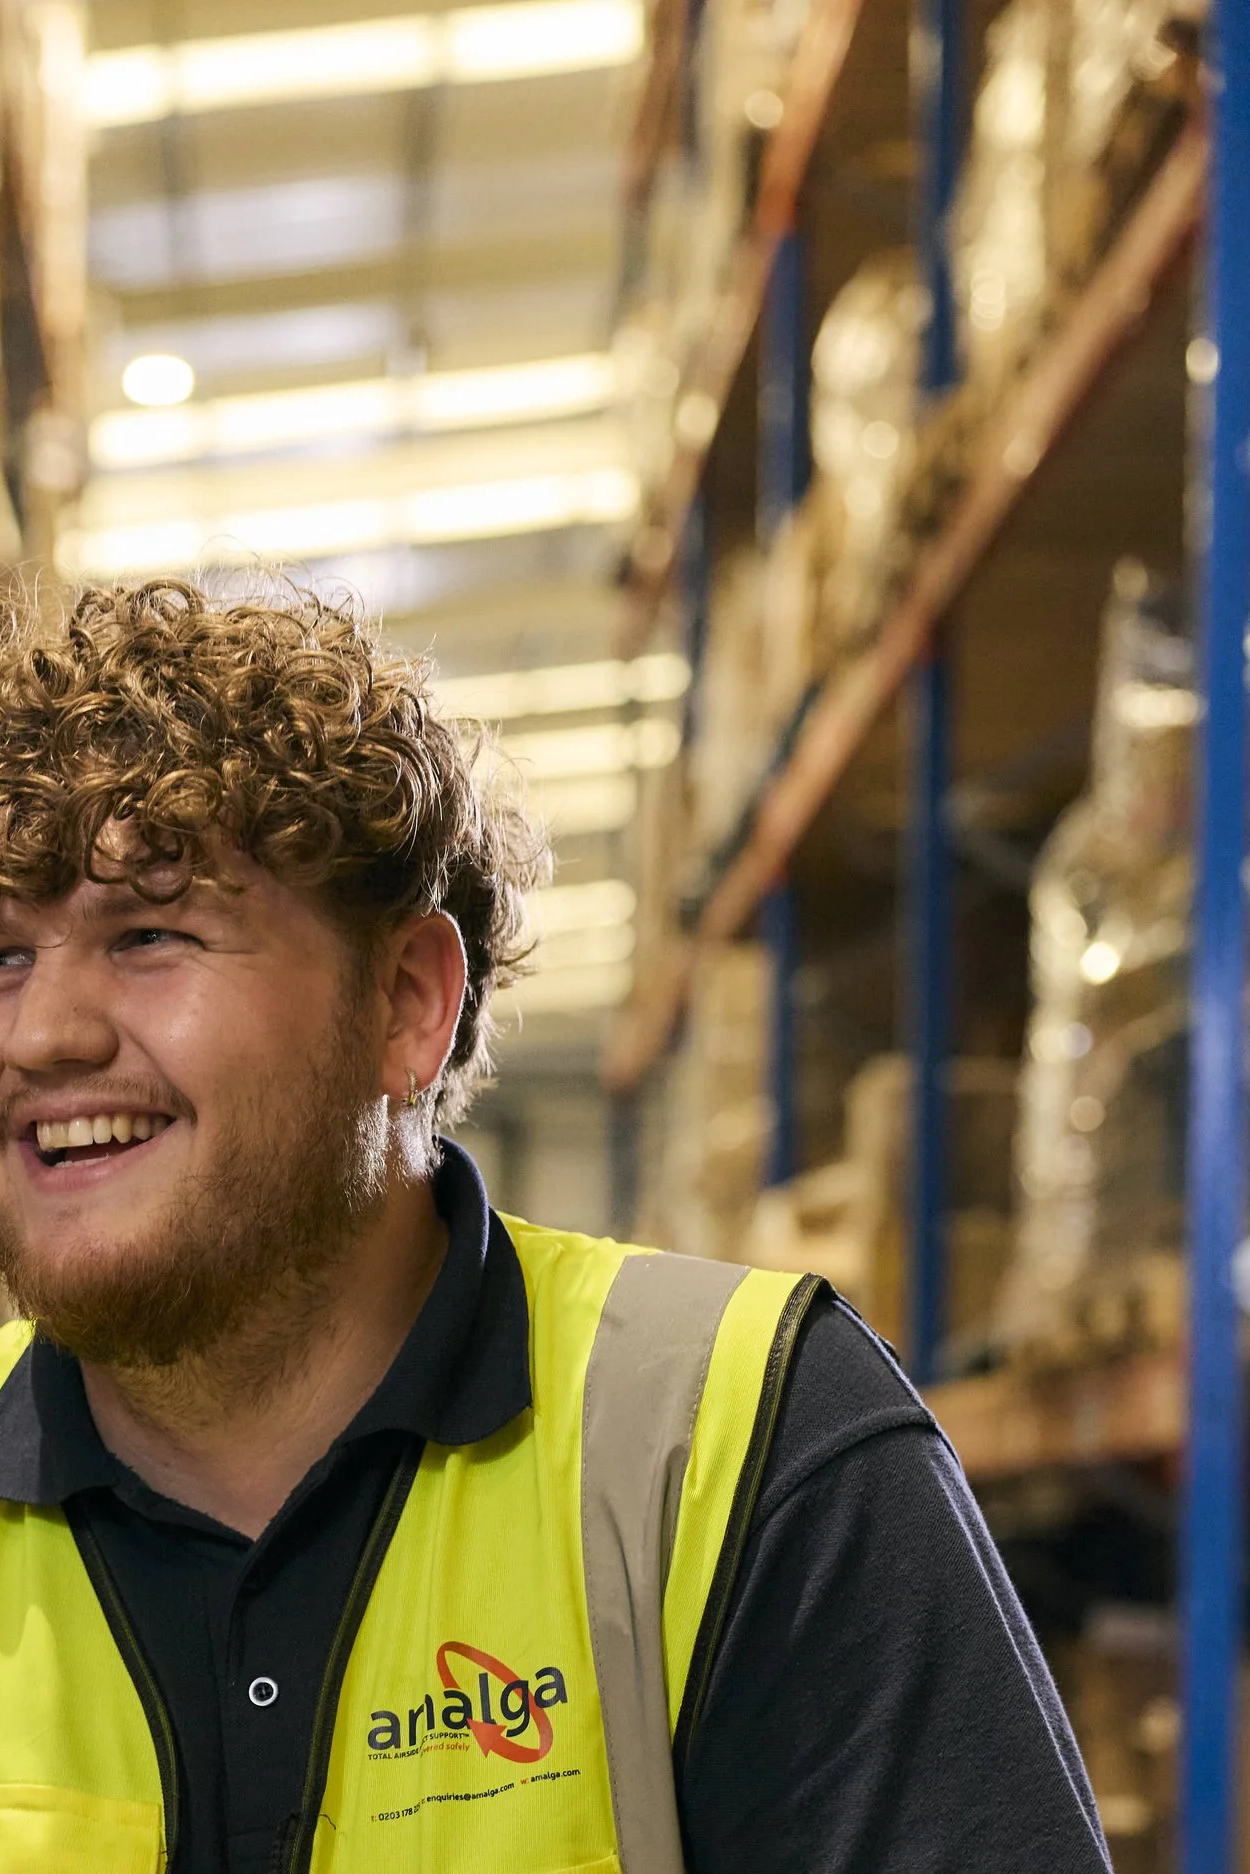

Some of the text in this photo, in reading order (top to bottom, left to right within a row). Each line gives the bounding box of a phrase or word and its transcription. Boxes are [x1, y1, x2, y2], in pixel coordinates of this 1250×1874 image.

[445, 1742, 470, 1752] safely
[394, 1748, 419, 1759] AIRSIDE
[378, 1811, 400, 1821] 0203
[401, 1807, 413, 1817] 178
[426, 1782, 515, 1803] enquiries@amalga.com
[530, 1768, 581, 1782] amalga.com
